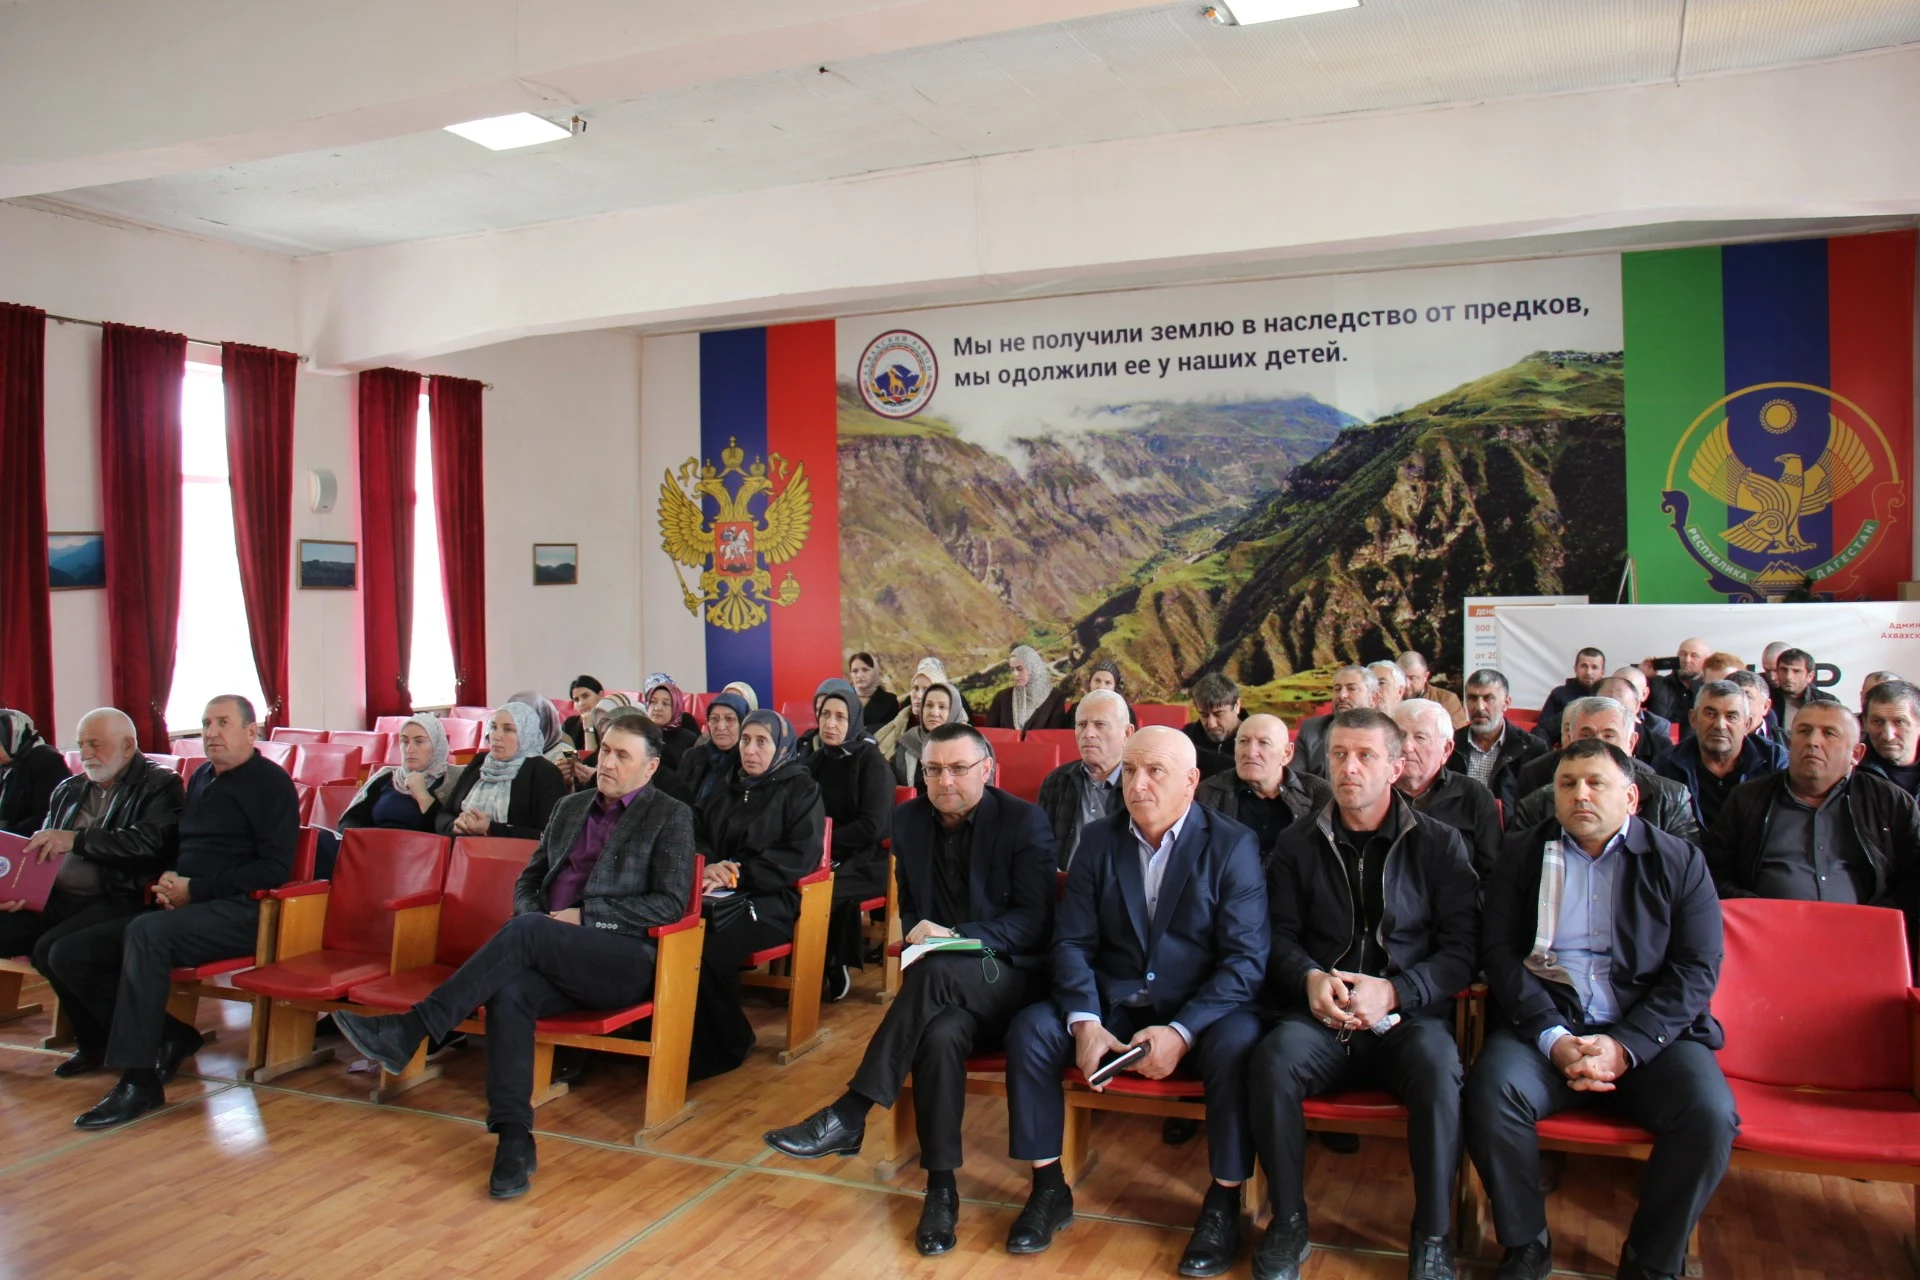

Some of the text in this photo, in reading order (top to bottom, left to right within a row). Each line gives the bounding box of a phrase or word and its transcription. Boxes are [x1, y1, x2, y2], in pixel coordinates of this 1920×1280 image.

[953, 296, 1590, 357] Мы не получили землю в наследство от предков,
[954, 340, 1348, 388] мы одолжили ее у наших детей.
[1688, 524, 1874, 581] РЕСПУБЛИКА ДАГЕСТАН
